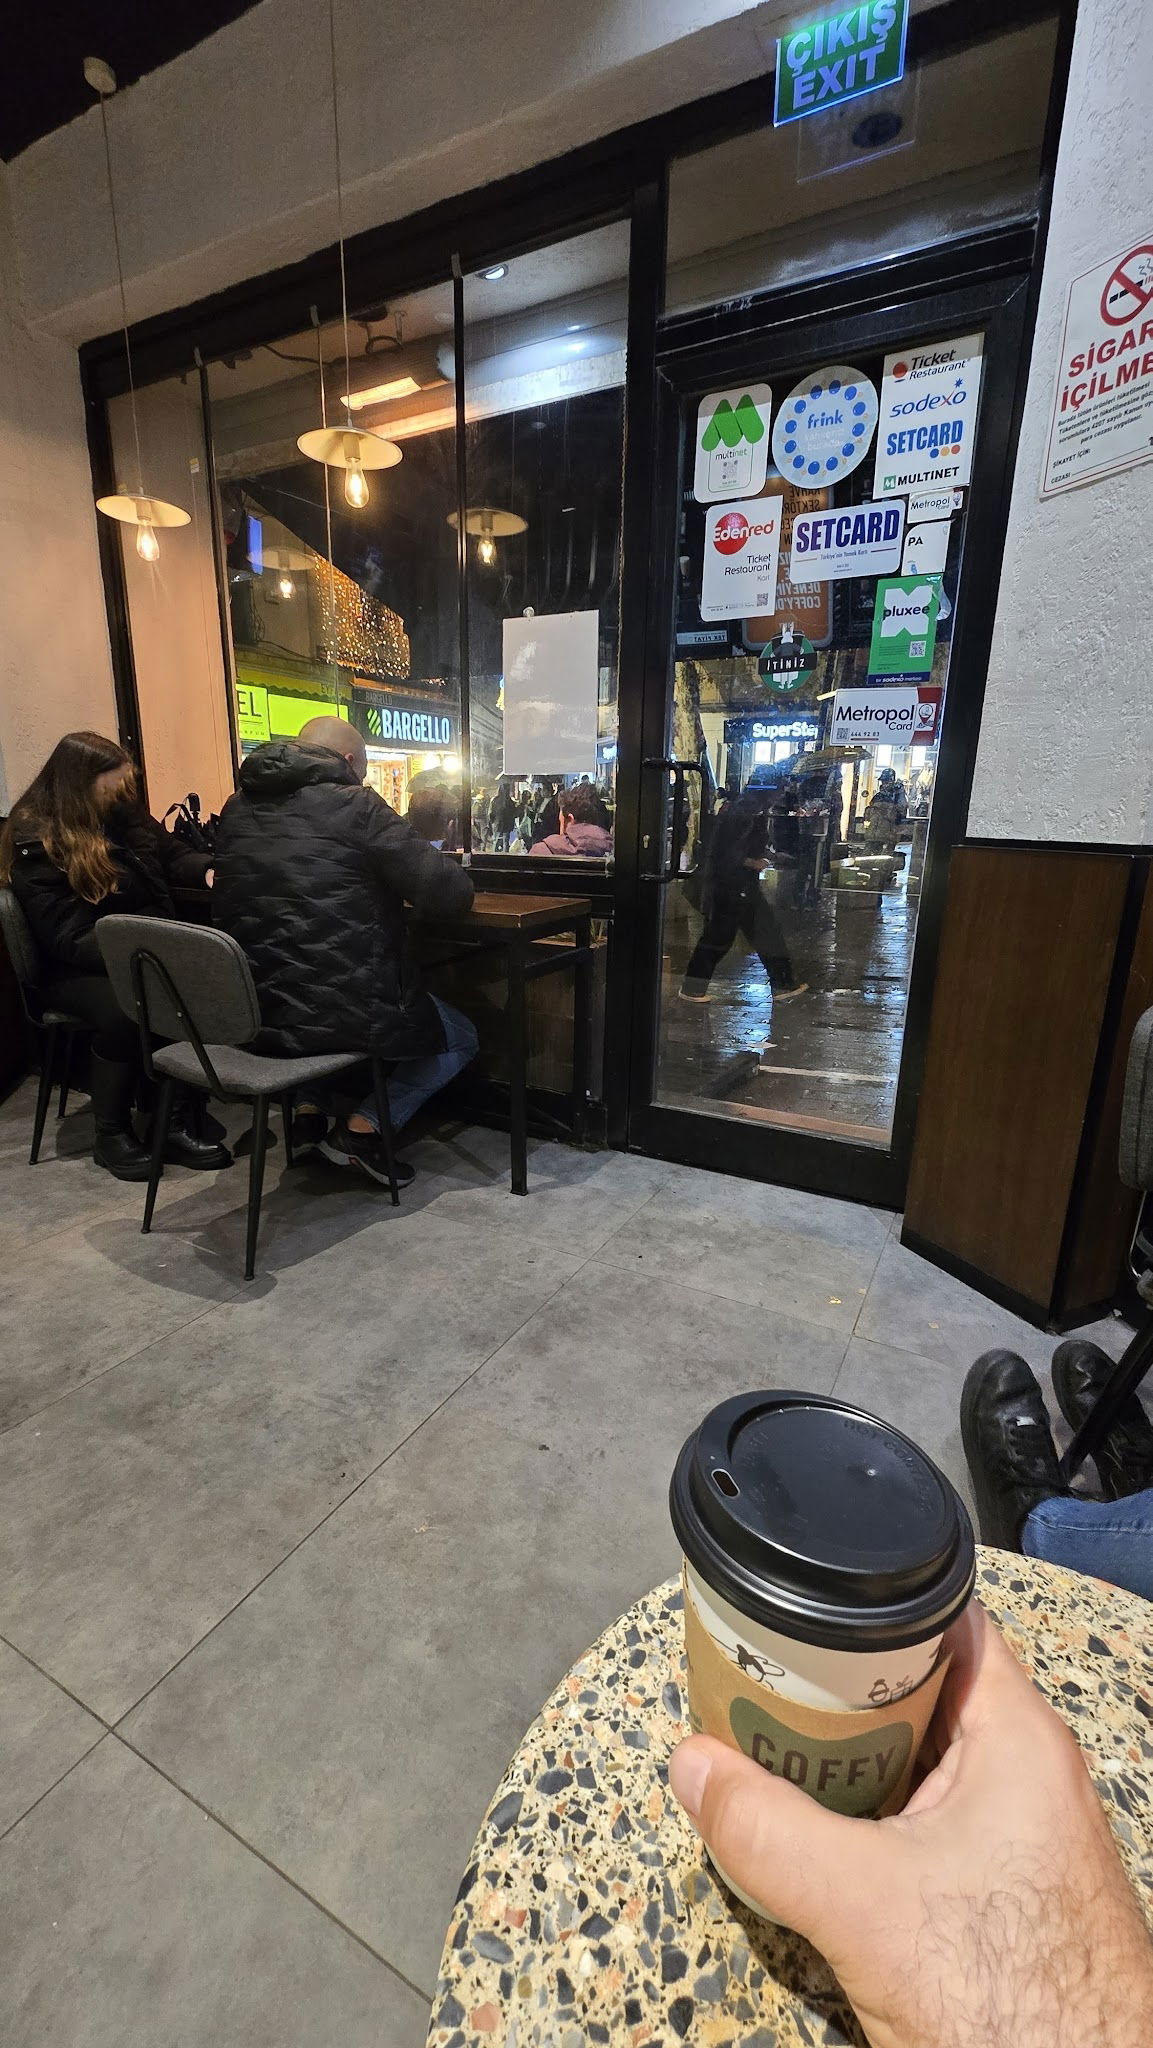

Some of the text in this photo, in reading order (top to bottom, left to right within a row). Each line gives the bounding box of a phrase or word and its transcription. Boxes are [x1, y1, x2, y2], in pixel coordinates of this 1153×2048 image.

[786, 0, 897, 78] ÇIKIŞ
[793, 44, 886, 110] EXIT
[911, 349, 957, 370] Ticket
[909, 360, 966, 380] Restaurant
[889, 387, 967, 418] sodexo
[807, 409, 844, 430] frink
[1092, 418, 1106, 429] 4207
[1123, 404, 1143, 416] Kanun
[886, 420, 964, 456] SETCARD
[1080, 433, 1092, 444] para
[1094, 426, 1112, 438] cezası
[715, 448, 748, 461] multinet
[1052, 453, 1076, 469] ŞİKAYET
[897, 466, 960, 486] MULTINET
[1050, 472, 1071, 484] CEZASI
[911, 496, 950, 510] Metropol
[713, 520, 775, 542] Edenred
[796, 509, 900, 553] SETCARD
[908, 536, 923, 546] PA
[747, 553, 772, 564] Ticket
[724, 563, 771, 576] Restaurant
[757, 574, 770, 582] Kart
[882, 605, 930, 620] pluxee
[365, 692, 393, 706] BARGELLO
[836, 705, 915, 724] Metropol
[381, 708, 450, 744] BARGELLO
[888, 722, 913, 731] Card
[751, 1732, 896, 1792] COFFY
